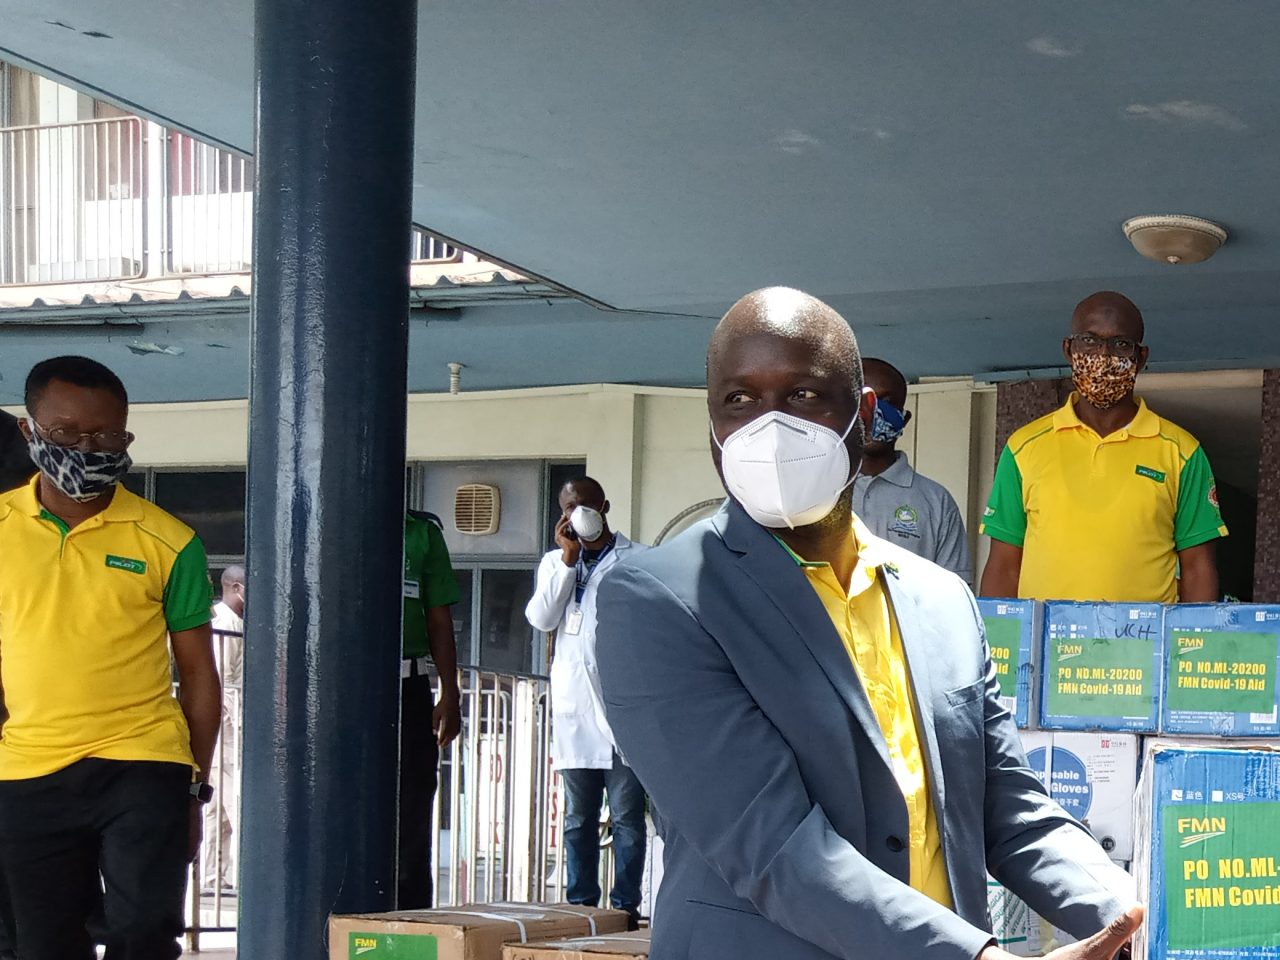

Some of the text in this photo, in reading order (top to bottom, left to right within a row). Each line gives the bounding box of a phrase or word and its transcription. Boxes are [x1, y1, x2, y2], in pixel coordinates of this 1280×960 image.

[1178, 638, 1203, 647] FMN
[1057, 645, 1082, 654] FMN
[1178, 661, 1192, 673] PO
[1058, 668, 1072, 679] PO
[1058, 683, 1142, 696] FMN Covid-19 Aid
[1178, 677, 1265, 691] FMN Covid-19 Aid
[1051, 782, 1089, 794] Gloves
[1178, 817, 1226, 833] FMN
[1183, 859, 1209, 880] PO
[1185, 887, 1225, 909] FMN
[355, 938, 376, 948] FMN
